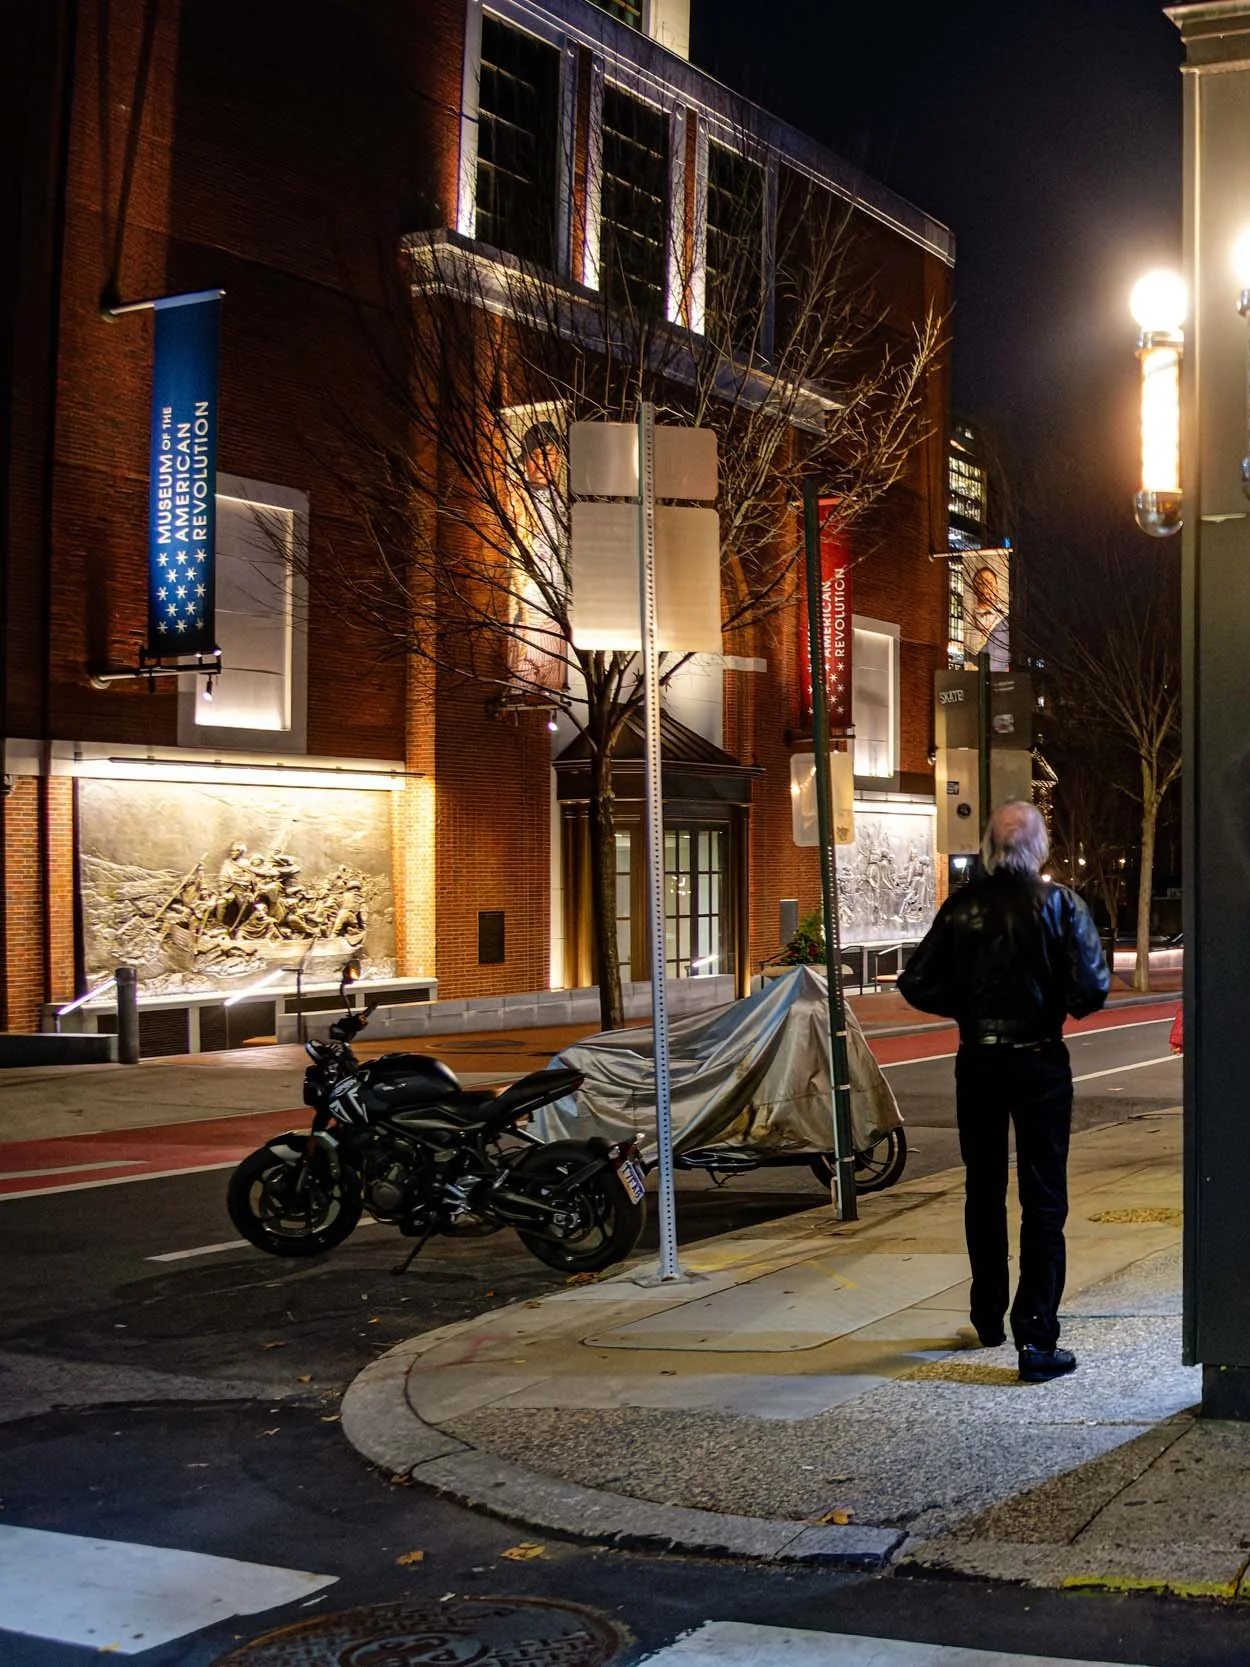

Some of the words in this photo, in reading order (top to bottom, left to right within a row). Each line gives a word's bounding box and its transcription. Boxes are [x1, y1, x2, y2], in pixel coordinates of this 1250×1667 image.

[161, 406, 173, 430] THE
[161, 433, 172, 451] OF
[158, 454, 173, 545] MUSEUM
[175, 423, 191, 541] AMERICAN
[193, 401, 209, 541] REVOLUTION
[834, 567, 846, 658] REVOLUTION
